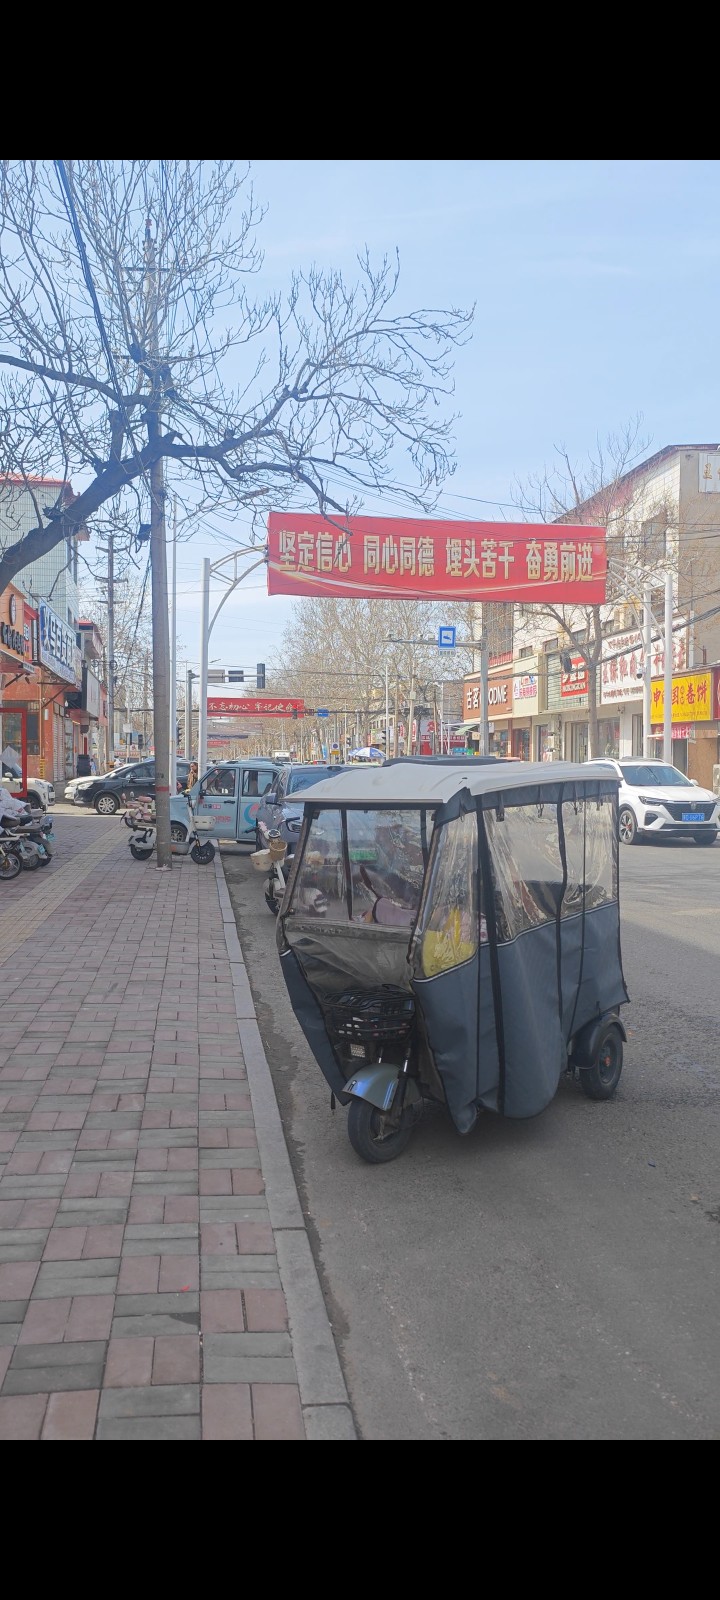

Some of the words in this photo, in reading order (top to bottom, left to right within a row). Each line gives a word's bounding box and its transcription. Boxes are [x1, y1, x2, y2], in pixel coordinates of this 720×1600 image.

[279, 530, 352, 573] 坚定信心
[363, 535, 435, 577] 同心同德
[445, 537, 515, 580] 埋头苦干
[526, 538, 593, 582] 奋勇前进
[208, 701, 251, 711] 不忘初心
[254, 701, 295, 712] 牢记使命
[466, 687, 480, 710] 古茗
